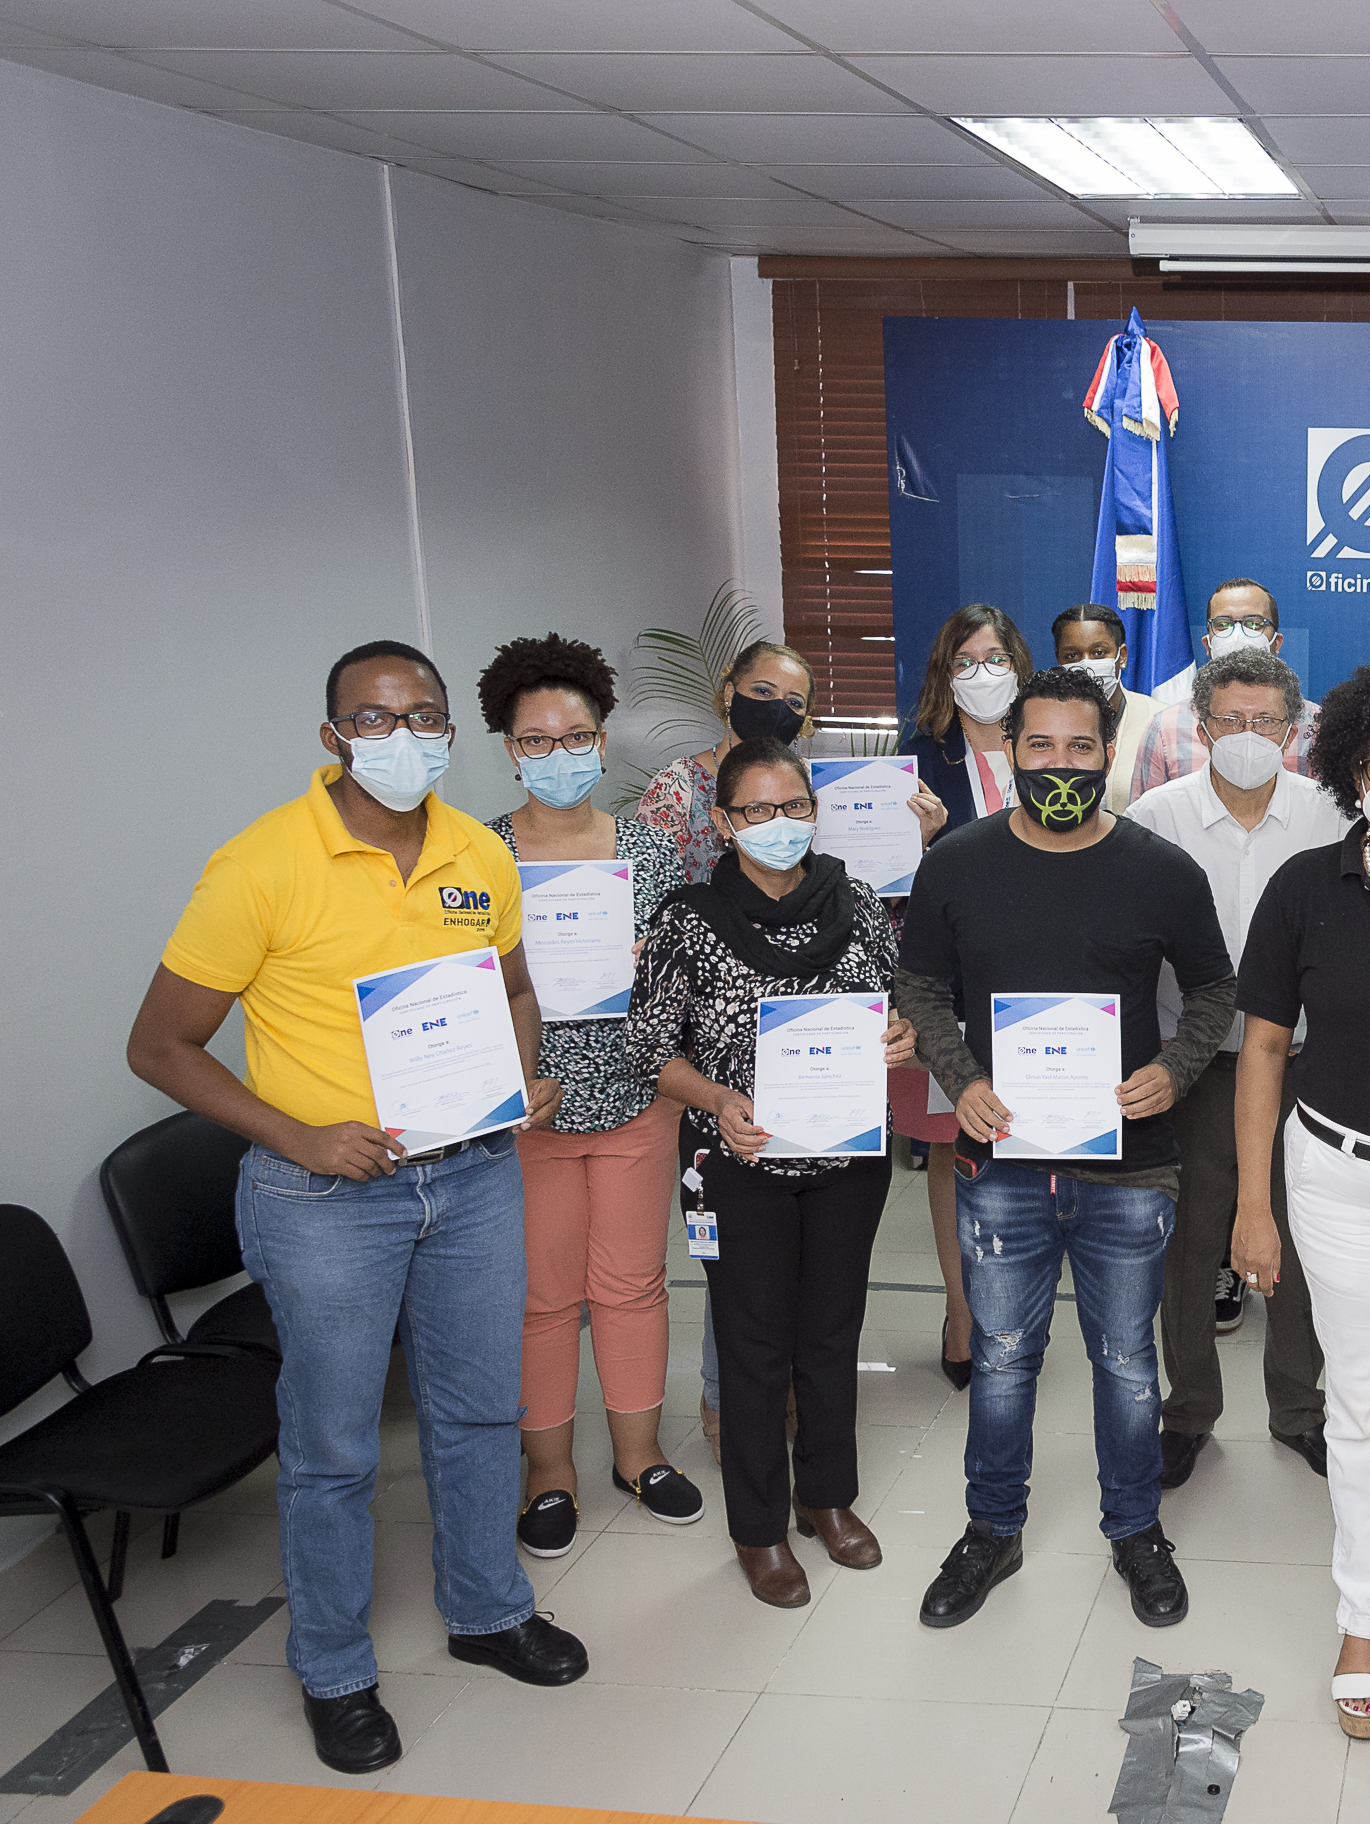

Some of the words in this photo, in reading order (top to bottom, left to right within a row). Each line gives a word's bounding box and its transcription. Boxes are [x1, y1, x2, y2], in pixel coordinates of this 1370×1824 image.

[556, 912, 579, 920] ENE
[444, 918, 488, 927] ENHOGAR
[422, 1018, 447, 1031] ENE
[809, 1047, 832, 1055] ENE
[1045, 1047, 1067, 1055] ENE
